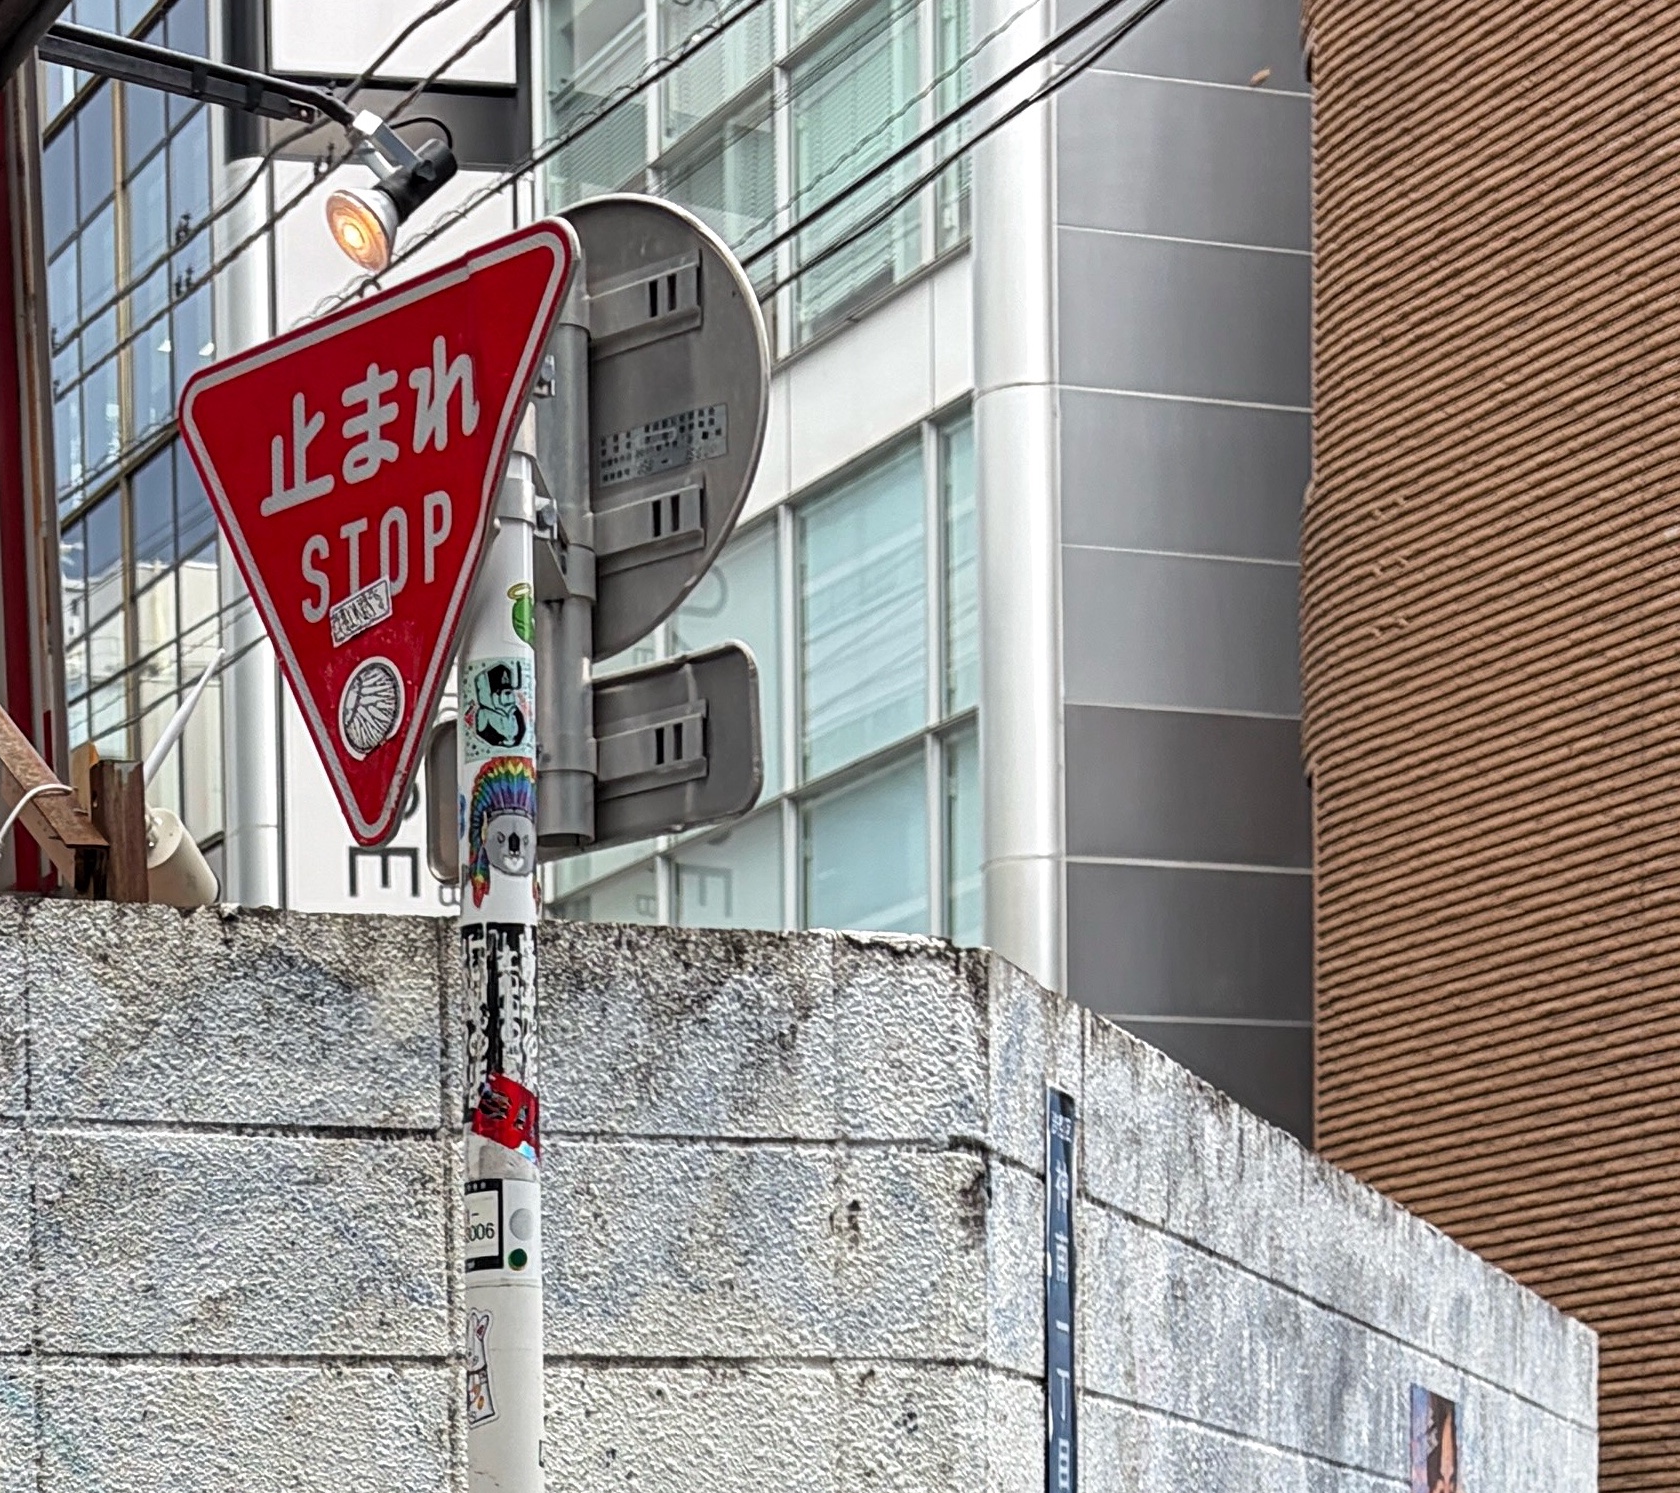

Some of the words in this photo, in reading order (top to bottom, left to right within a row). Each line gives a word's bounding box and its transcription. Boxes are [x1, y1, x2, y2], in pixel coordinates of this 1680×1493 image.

[261, 335, 480, 517] 止まれ
[301, 490, 452, 623] STOP
